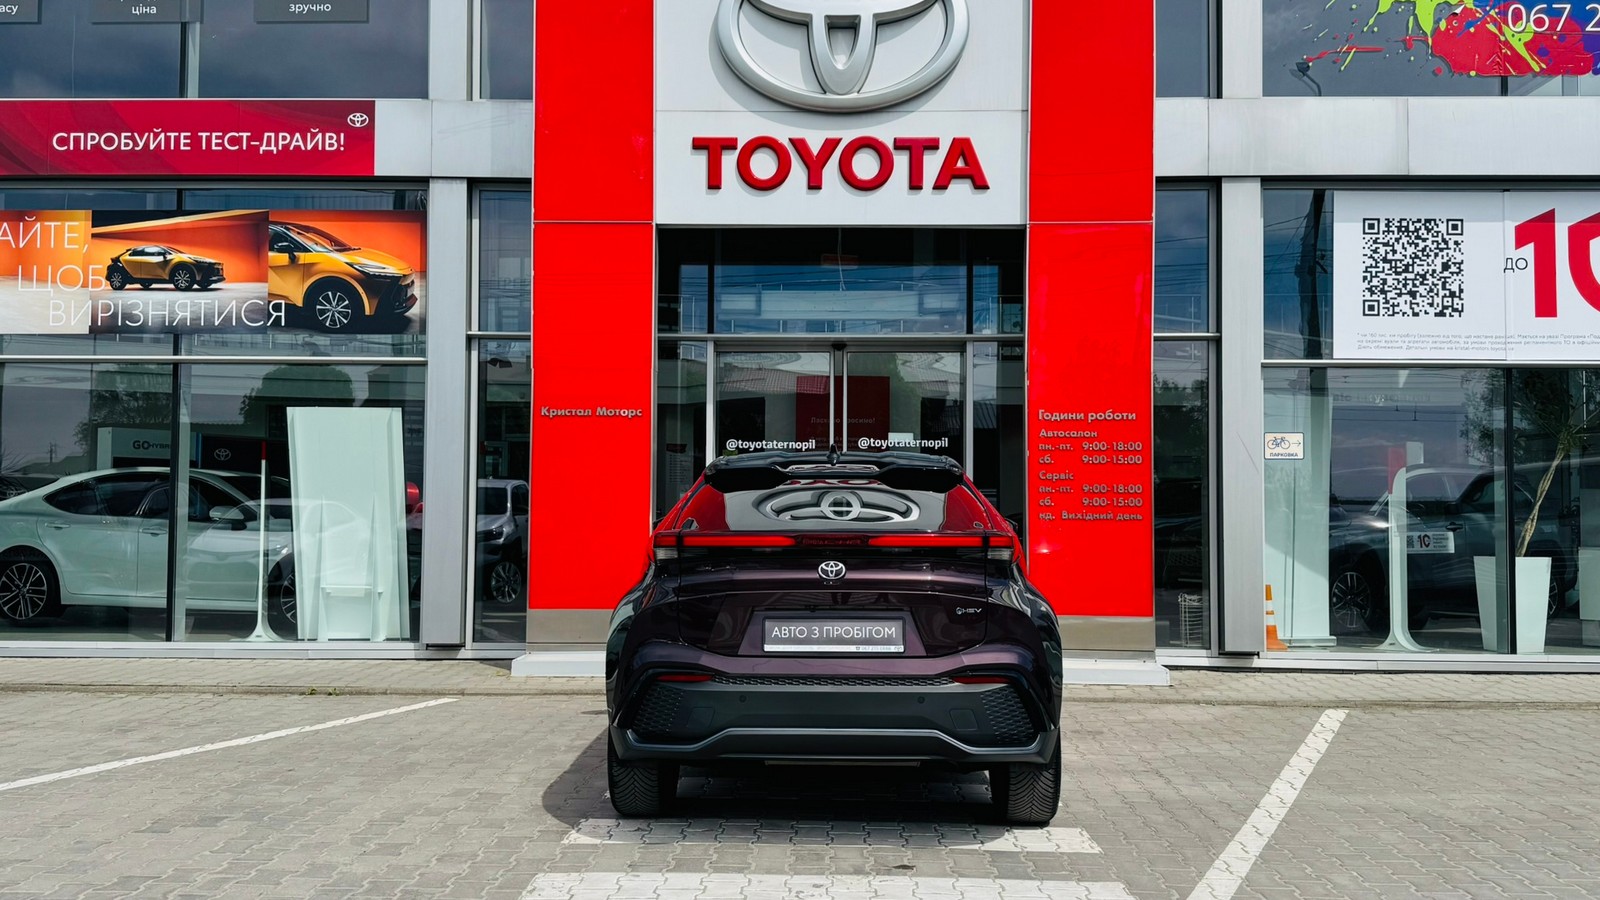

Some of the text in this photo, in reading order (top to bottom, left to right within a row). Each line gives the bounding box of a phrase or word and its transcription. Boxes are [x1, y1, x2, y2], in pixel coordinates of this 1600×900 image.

[132, 4, 157, 14] ціна
[288, 3, 332, 14] зручно
[1507, 3, 1571, 32] 067
[52, 128, 345, 154] СПРОБУЙТЕ ТЕСТ-ДРАЙВ!
[692, 135, 990, 192] TOYOTA
[18, 264, 105, 297] ЩОБ
[49, 299, 286, 327] ВИРІЗНЯТИСЯ
[541, 406, 642, 419] Кристал Моторс
[1039, 409, 1136, 422] Години роботи
[1039, 429, 1098, 438] Автосалон
[726, 438, 816, 451] @toyotaternopil
[857, 437, 949, 450] @toyotaternopil
[1039, 443, 1074, 451] пн.-пт.
[1039, 454, 1054, 464] сб.
[1039, 470, 1074, 482] Сервіс
[1039, 485, 1074, 493] пн.-пт.
[1039, 497, 1055, 506] сб.
[1039, 511, 1056, 520] нд.
[1061, 510, 1114, 520] Вихідний
[771, 626, 808, 638] АВТО
[823, 626, 896, 638] ПРОБІГОМ
